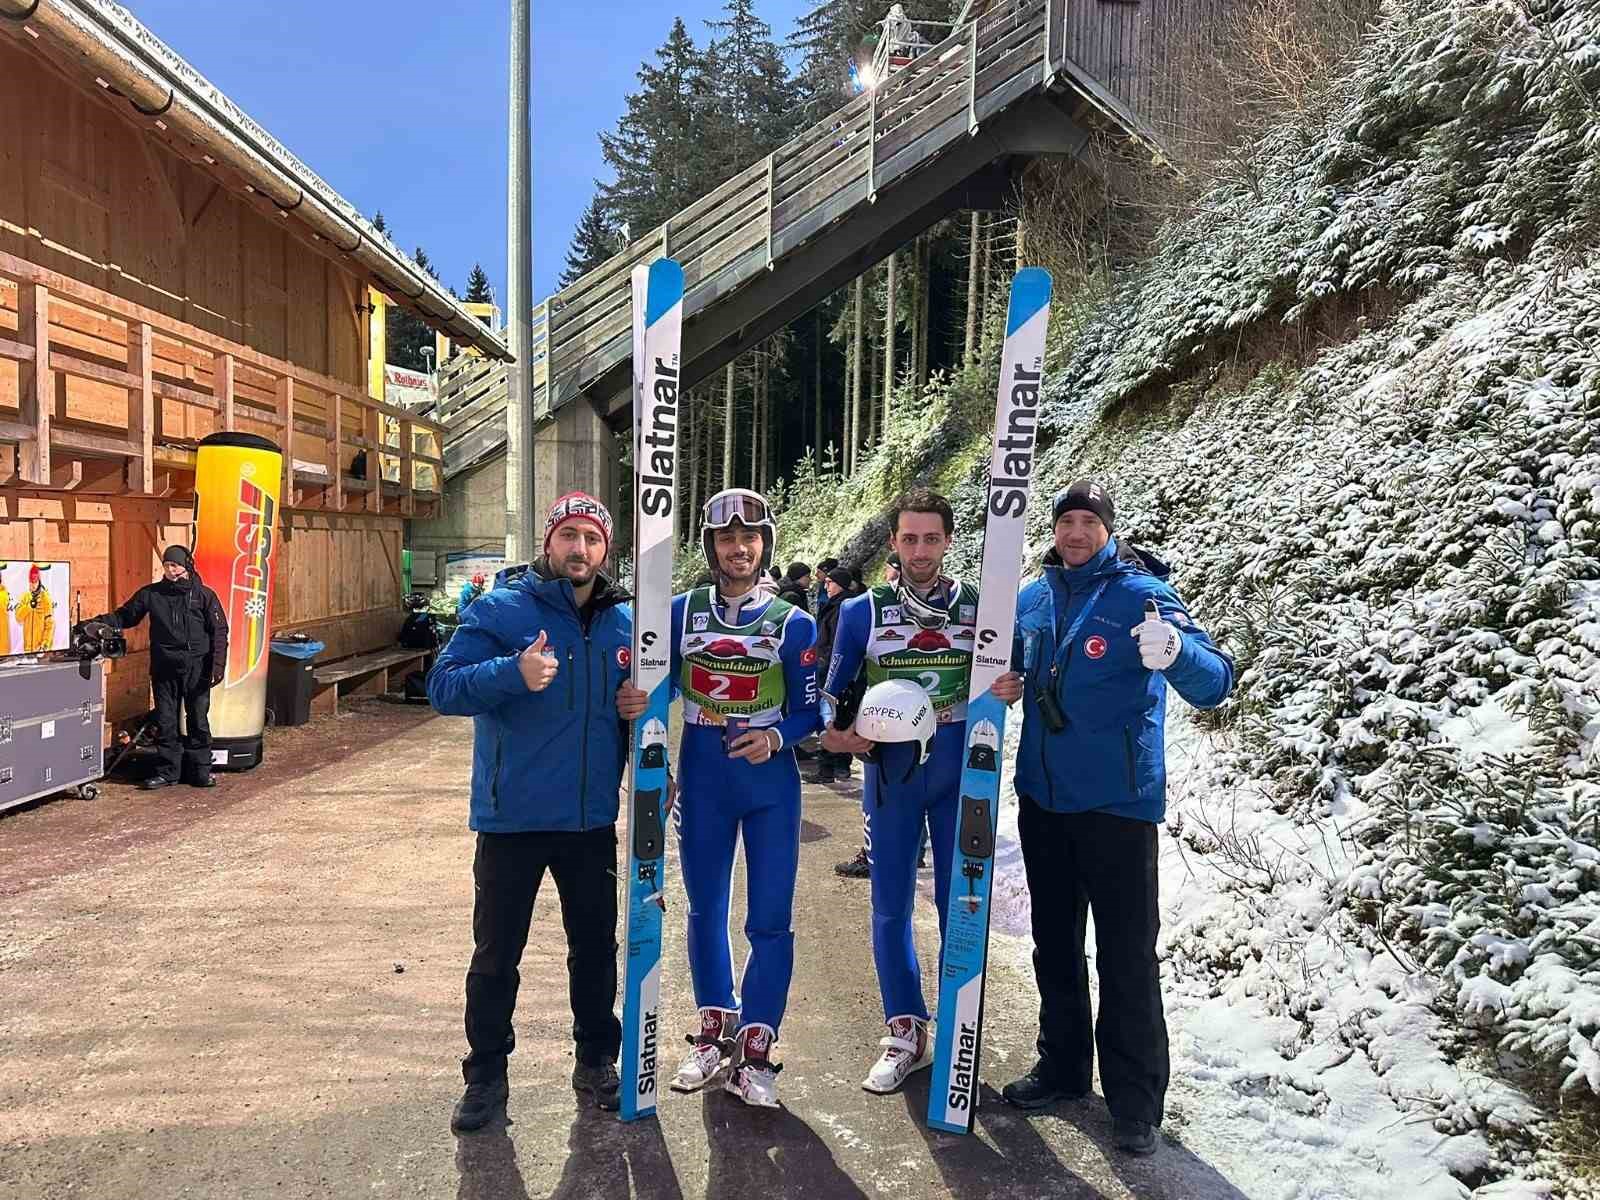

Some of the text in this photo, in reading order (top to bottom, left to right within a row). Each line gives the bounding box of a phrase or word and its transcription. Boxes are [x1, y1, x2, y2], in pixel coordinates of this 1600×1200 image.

[641, 356, 678, 519] Slatnar
[990, 362, 1041, 519] Slatnar
[640, 658, 667, 666] Slatnar
[976, 654, 1007, 666] Slatnar
[708, 675, 730, 699] 2
[805, 672, 816, 704] TUR
[918, 671, 940, 697] 2
[863, 706, 904, 721] CRYPEX
[911, 704, 928, 727] uvex
[638, 1011, 657, 1096] Slatnar
[948, 1023, 976, 1111] Slatnar
